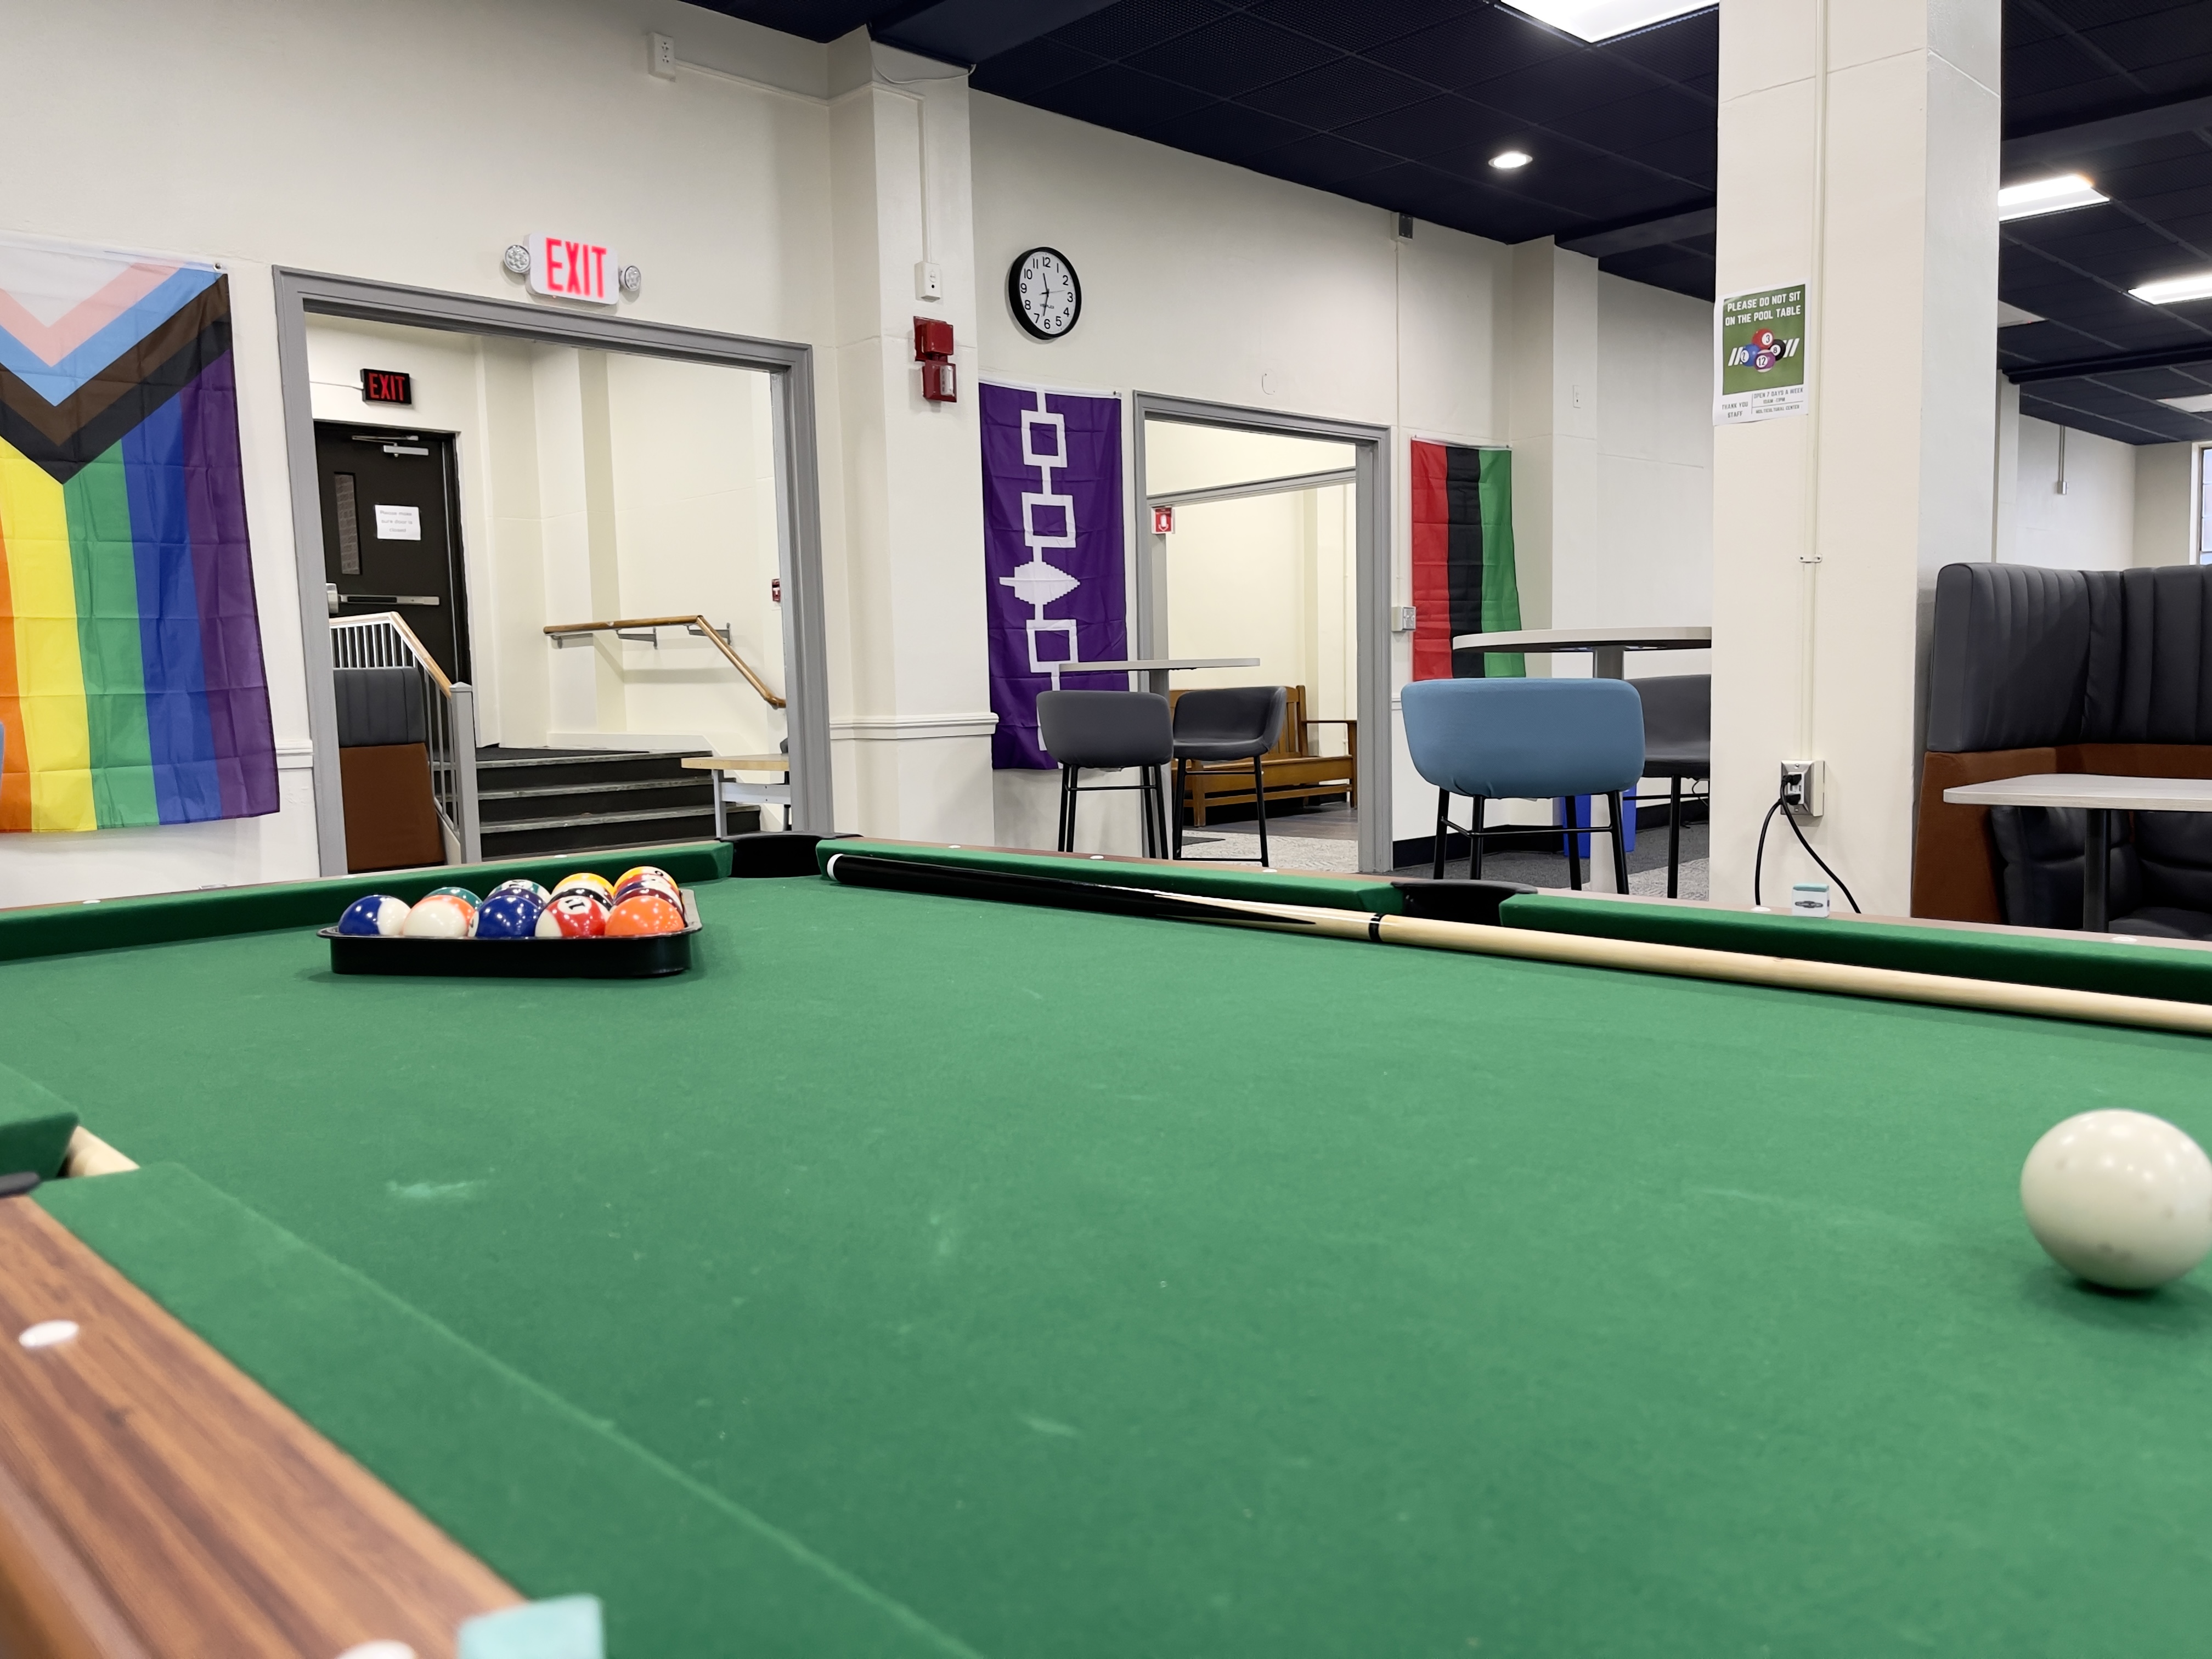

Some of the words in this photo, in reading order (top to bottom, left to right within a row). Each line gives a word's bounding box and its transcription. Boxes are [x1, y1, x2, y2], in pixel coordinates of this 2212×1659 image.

[1033, 258, 1039, 269] 11
[1042, 256, 1051, 268] 12
[545, 237, 607, 298] EXIT
[1024, 268, 1032, 280] 10
[1063, 275, 1069, 286] 2
[1020, 283, 1027, 294] 9
[1067, 292, 1073, 302] 3
[1727, 299, 1757, 312] PLEASE
[1759, 297, 1769, 307] DO
[1771, 294, 1787, 304] NOT
[1789, 291, 1801, 302] SIT
[1024, 300, 1031, 310] 8
[1063, 307, 1069, 317] 4
[1725, 316, 1735, 326] ON
[1737, 313, 1751, 324] THE
[1754, 311, 1773, 321] POOL
[1776, 305, 1801, 318] TABLE
[1034, 313, 1040, 323] 7
[1056, 316, 1062, 326] 5
[1044, 319, 1051, 329] 6
[1766, 335, 1770, 343] 3
[1742, 352, 1746, 361] 2
[1758, 357, 1766, 366] 12
[369, 373, 405, 401] EXIT
